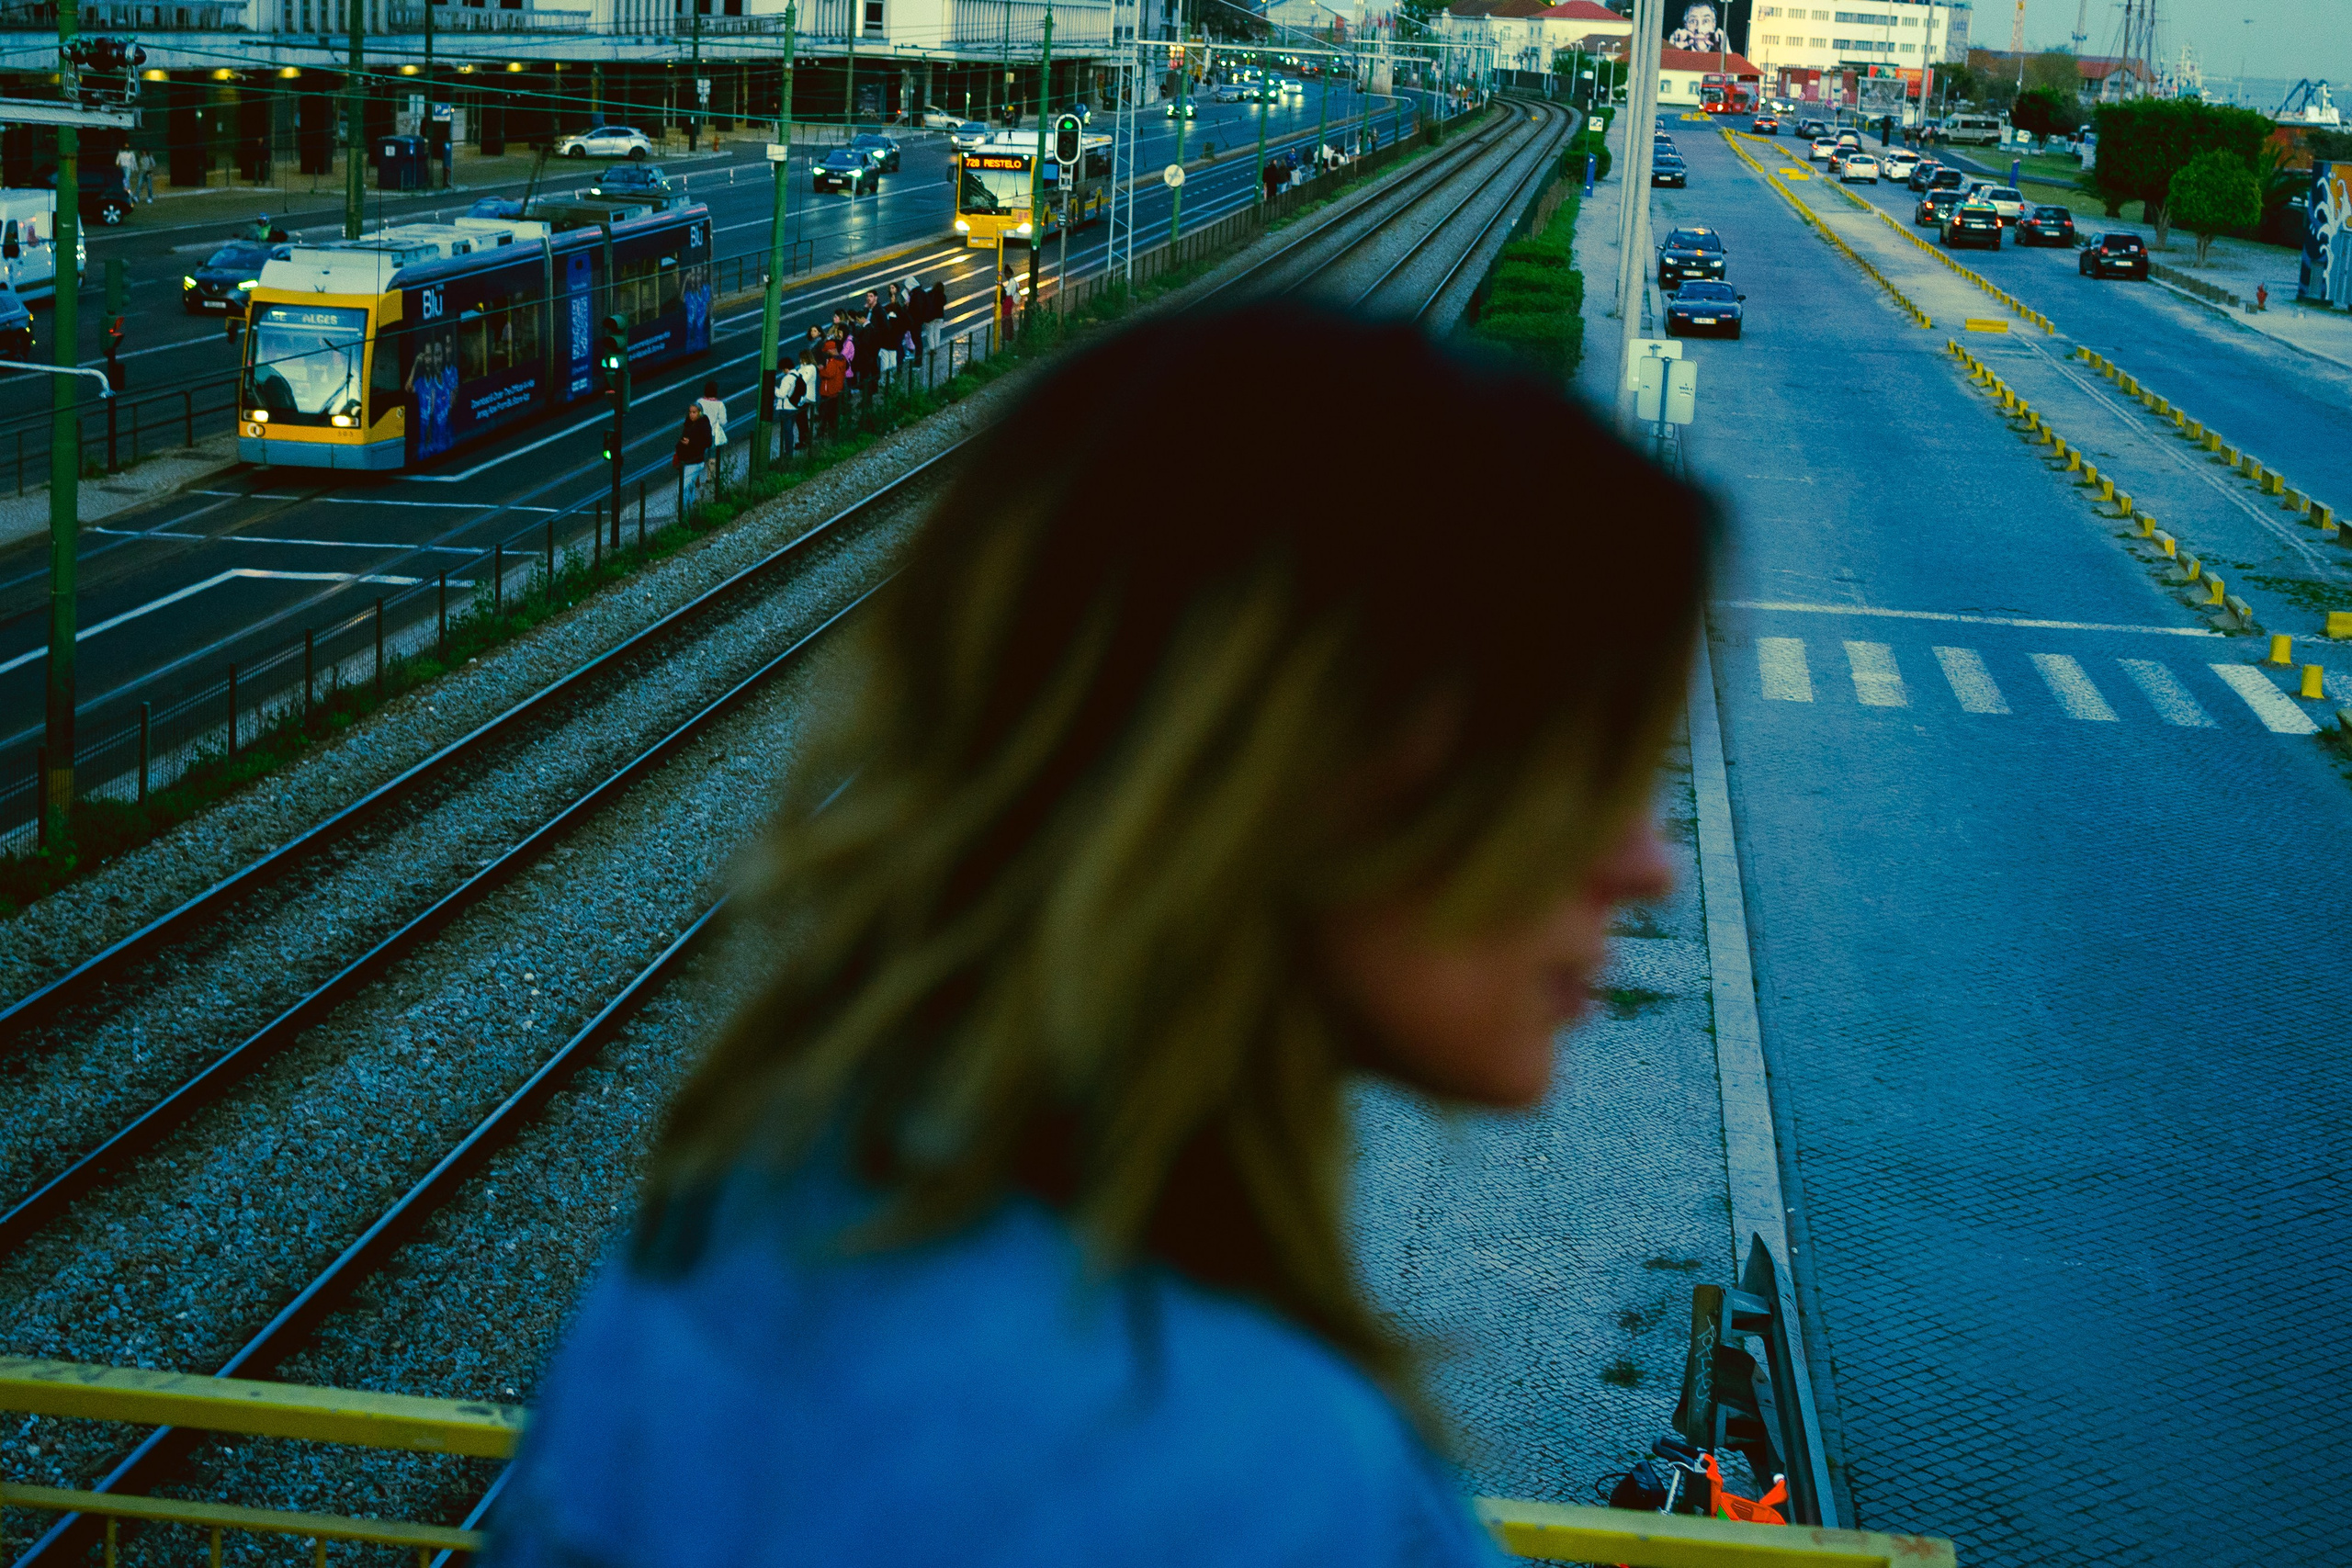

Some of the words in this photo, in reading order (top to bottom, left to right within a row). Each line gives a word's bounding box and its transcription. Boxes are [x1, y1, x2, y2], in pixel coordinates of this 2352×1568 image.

[966, 158, 980, 167] 728
[984, 159, 1022, 169] RESTELO
[423, 288, 443, 320] Blu
